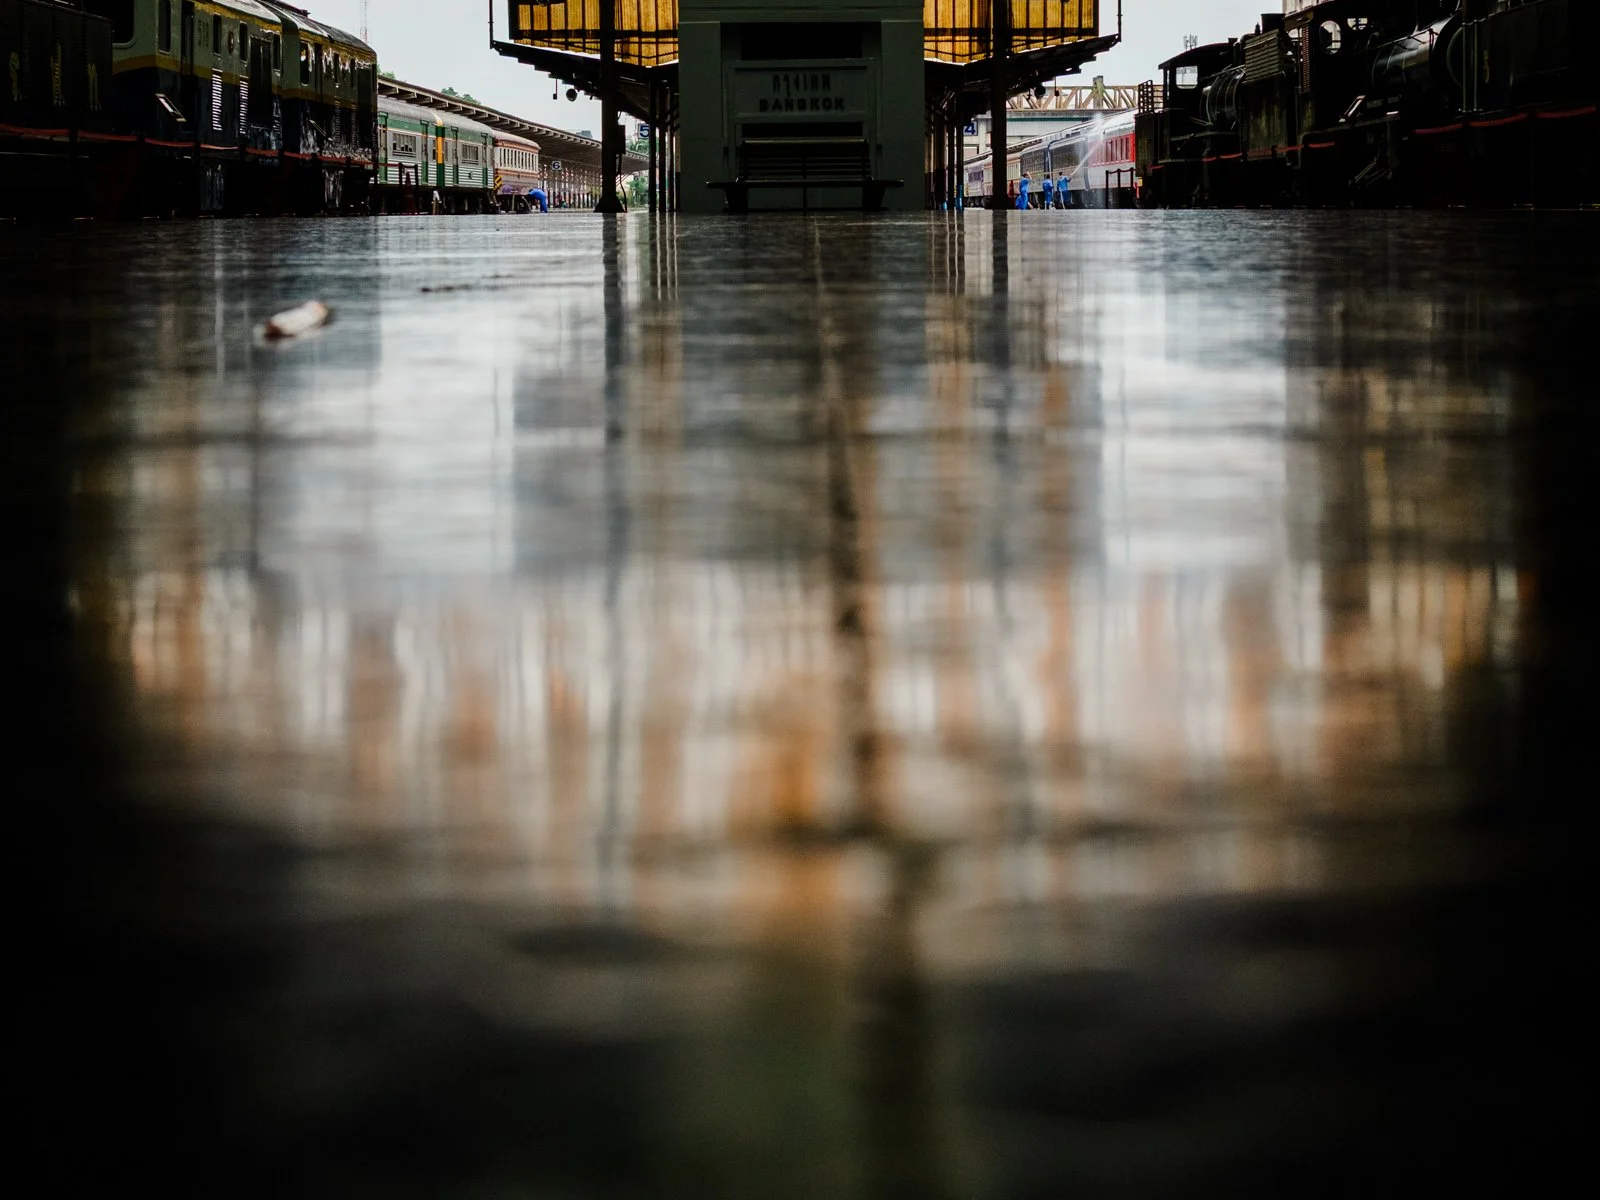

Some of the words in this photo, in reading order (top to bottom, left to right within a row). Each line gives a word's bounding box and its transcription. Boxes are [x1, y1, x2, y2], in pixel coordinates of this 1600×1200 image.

[772, 73, 831, 97] กรุงเทพ
[759, 97, 845, 112] BANGKOK
[964, 122, 976, 135] 4
[552, 161, 560, 170] 6
